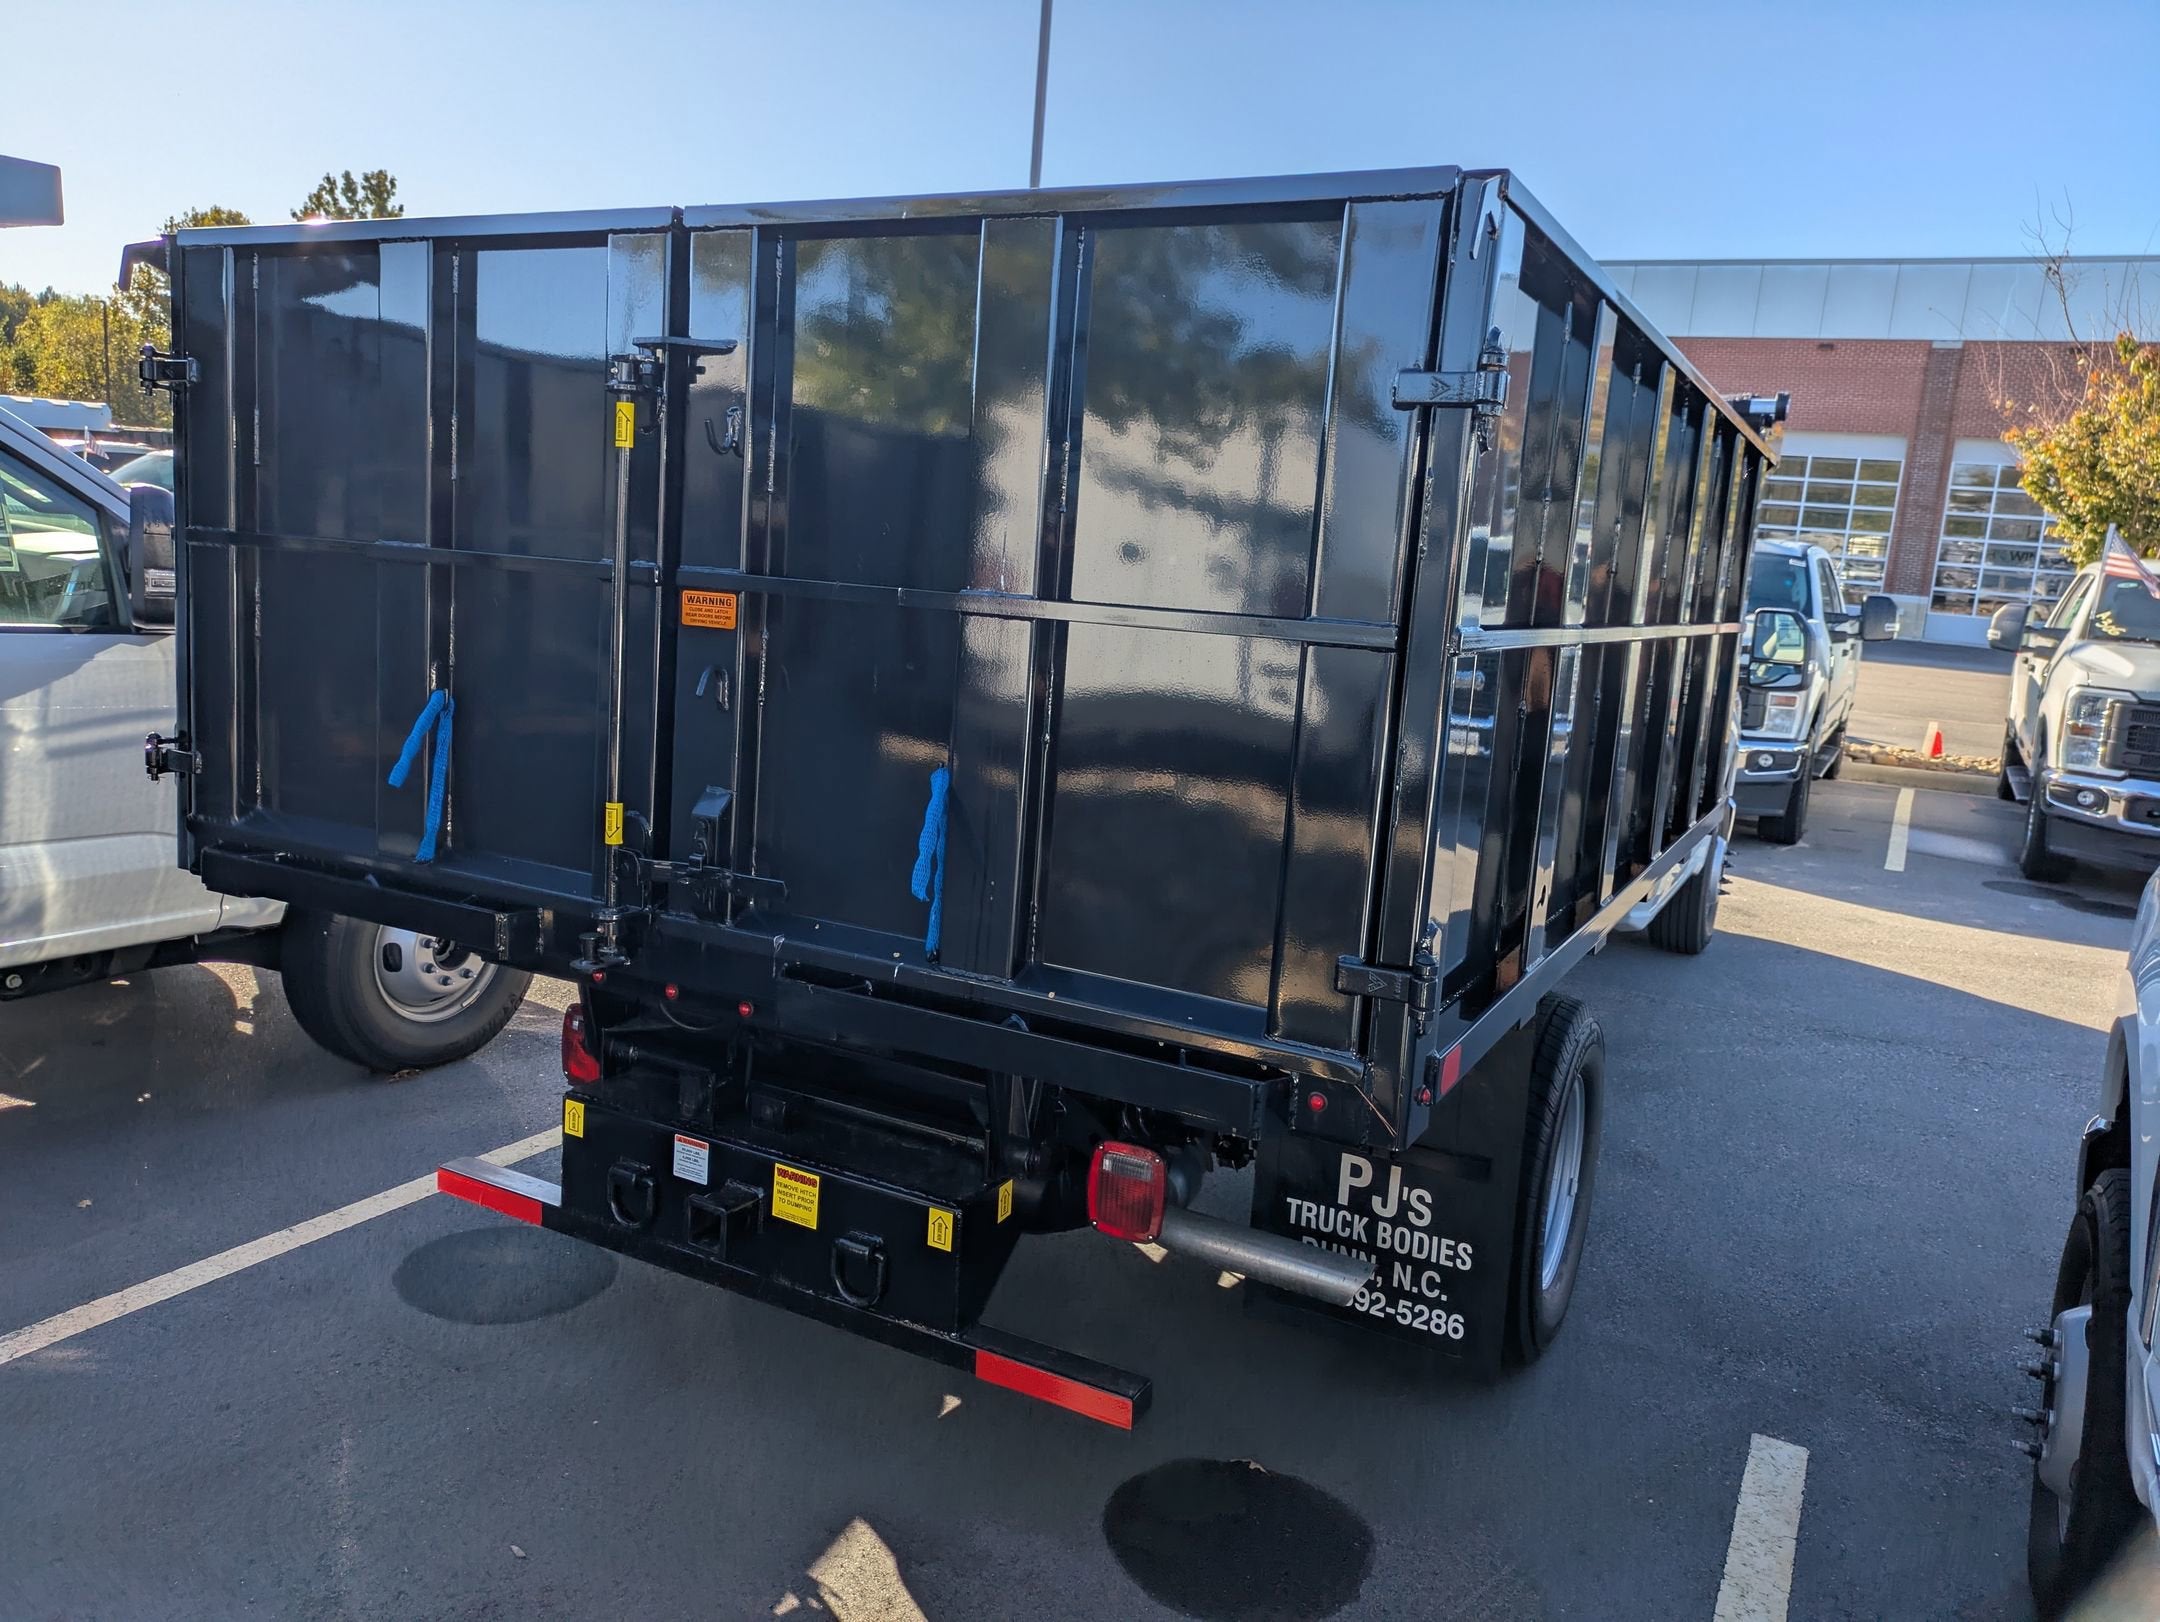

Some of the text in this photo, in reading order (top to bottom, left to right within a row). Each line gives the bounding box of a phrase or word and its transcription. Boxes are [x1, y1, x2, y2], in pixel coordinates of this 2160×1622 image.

[687, 595, 732, 607] WARNING
[776, 1167, 818, 1188] WARNING
[776, 1181, 817, 1198] REMOVE HITCH
[776, 1189, 815, 1206] INSERT PRIOR
[786, 1200, 812, 1213] DUMPING
[1286, 1197, 1369, 1244] TRUCK
[1376, 1221, 1473, 1271] BODIES
[1392, 1261, 1448, 1302] N.C.
[1345, 1286, 1465, 1340] 92-5286
